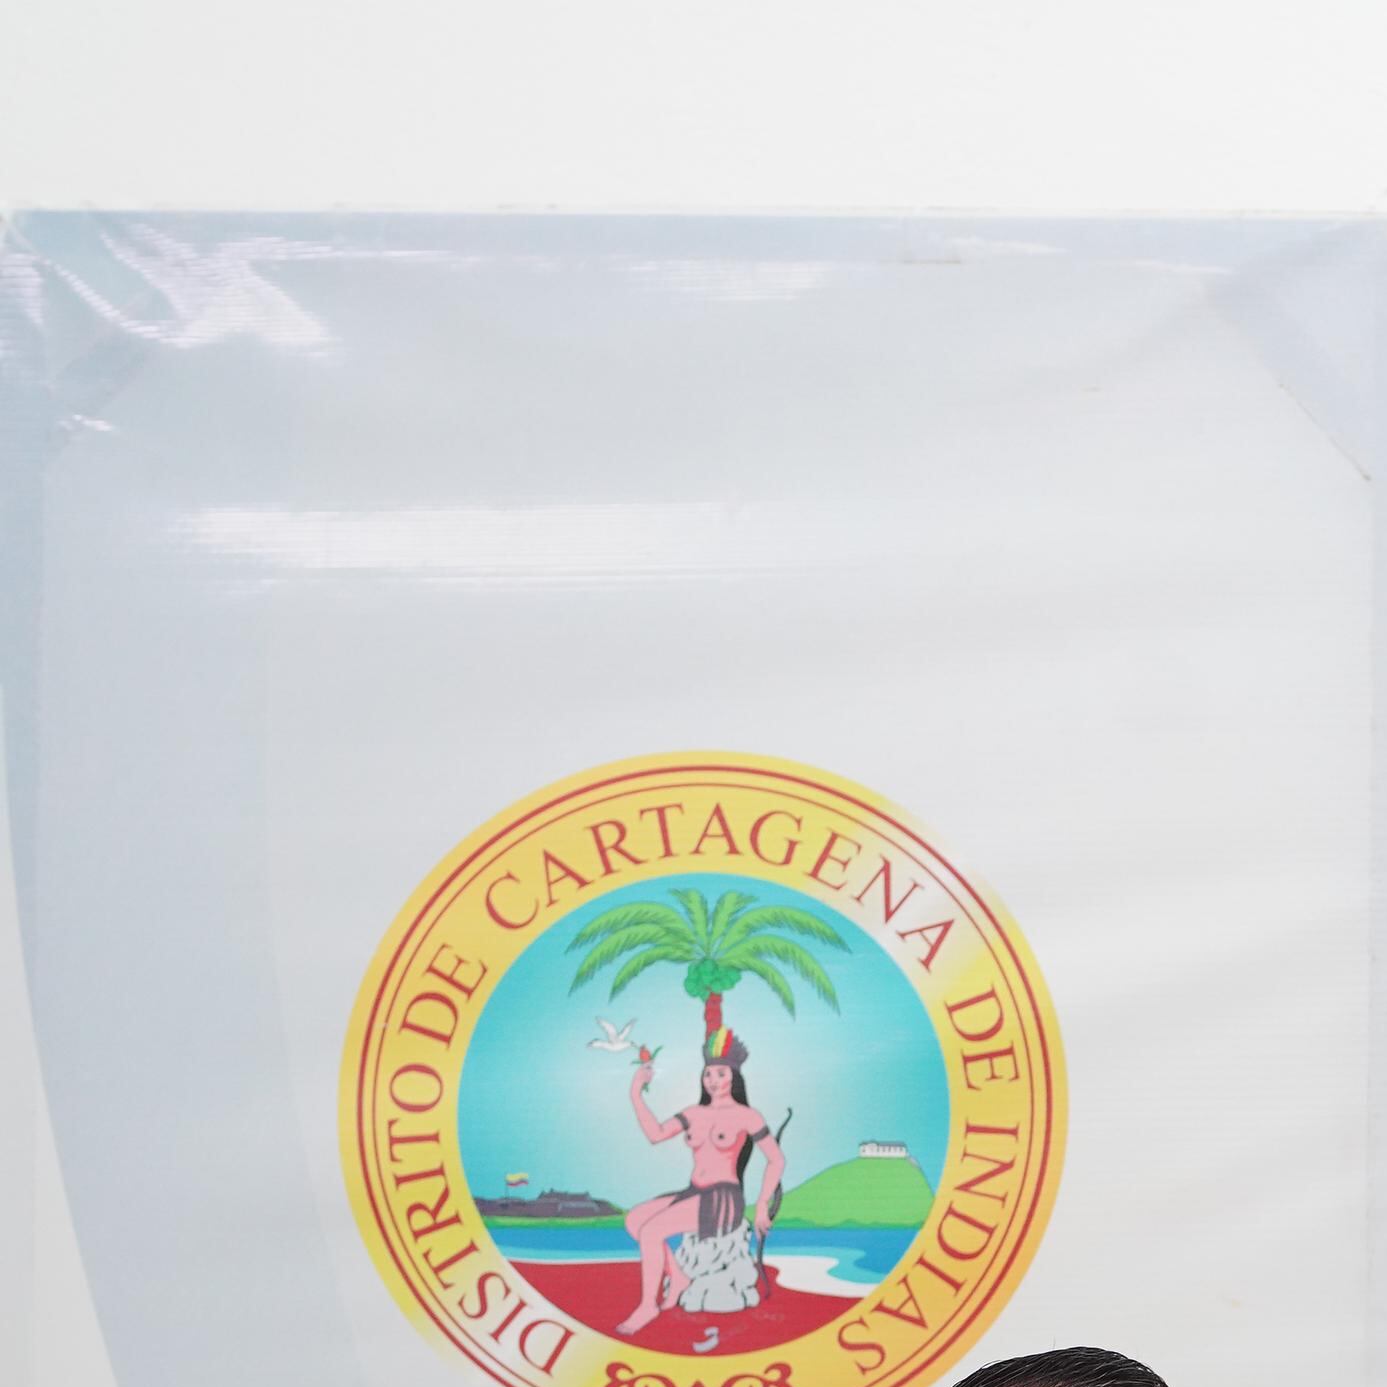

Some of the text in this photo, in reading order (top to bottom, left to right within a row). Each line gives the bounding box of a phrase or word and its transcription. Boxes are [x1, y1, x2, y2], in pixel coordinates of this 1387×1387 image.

[387, 802, 1022, 1378] DISTRITO DE CARTAGENA DE INDIAS
